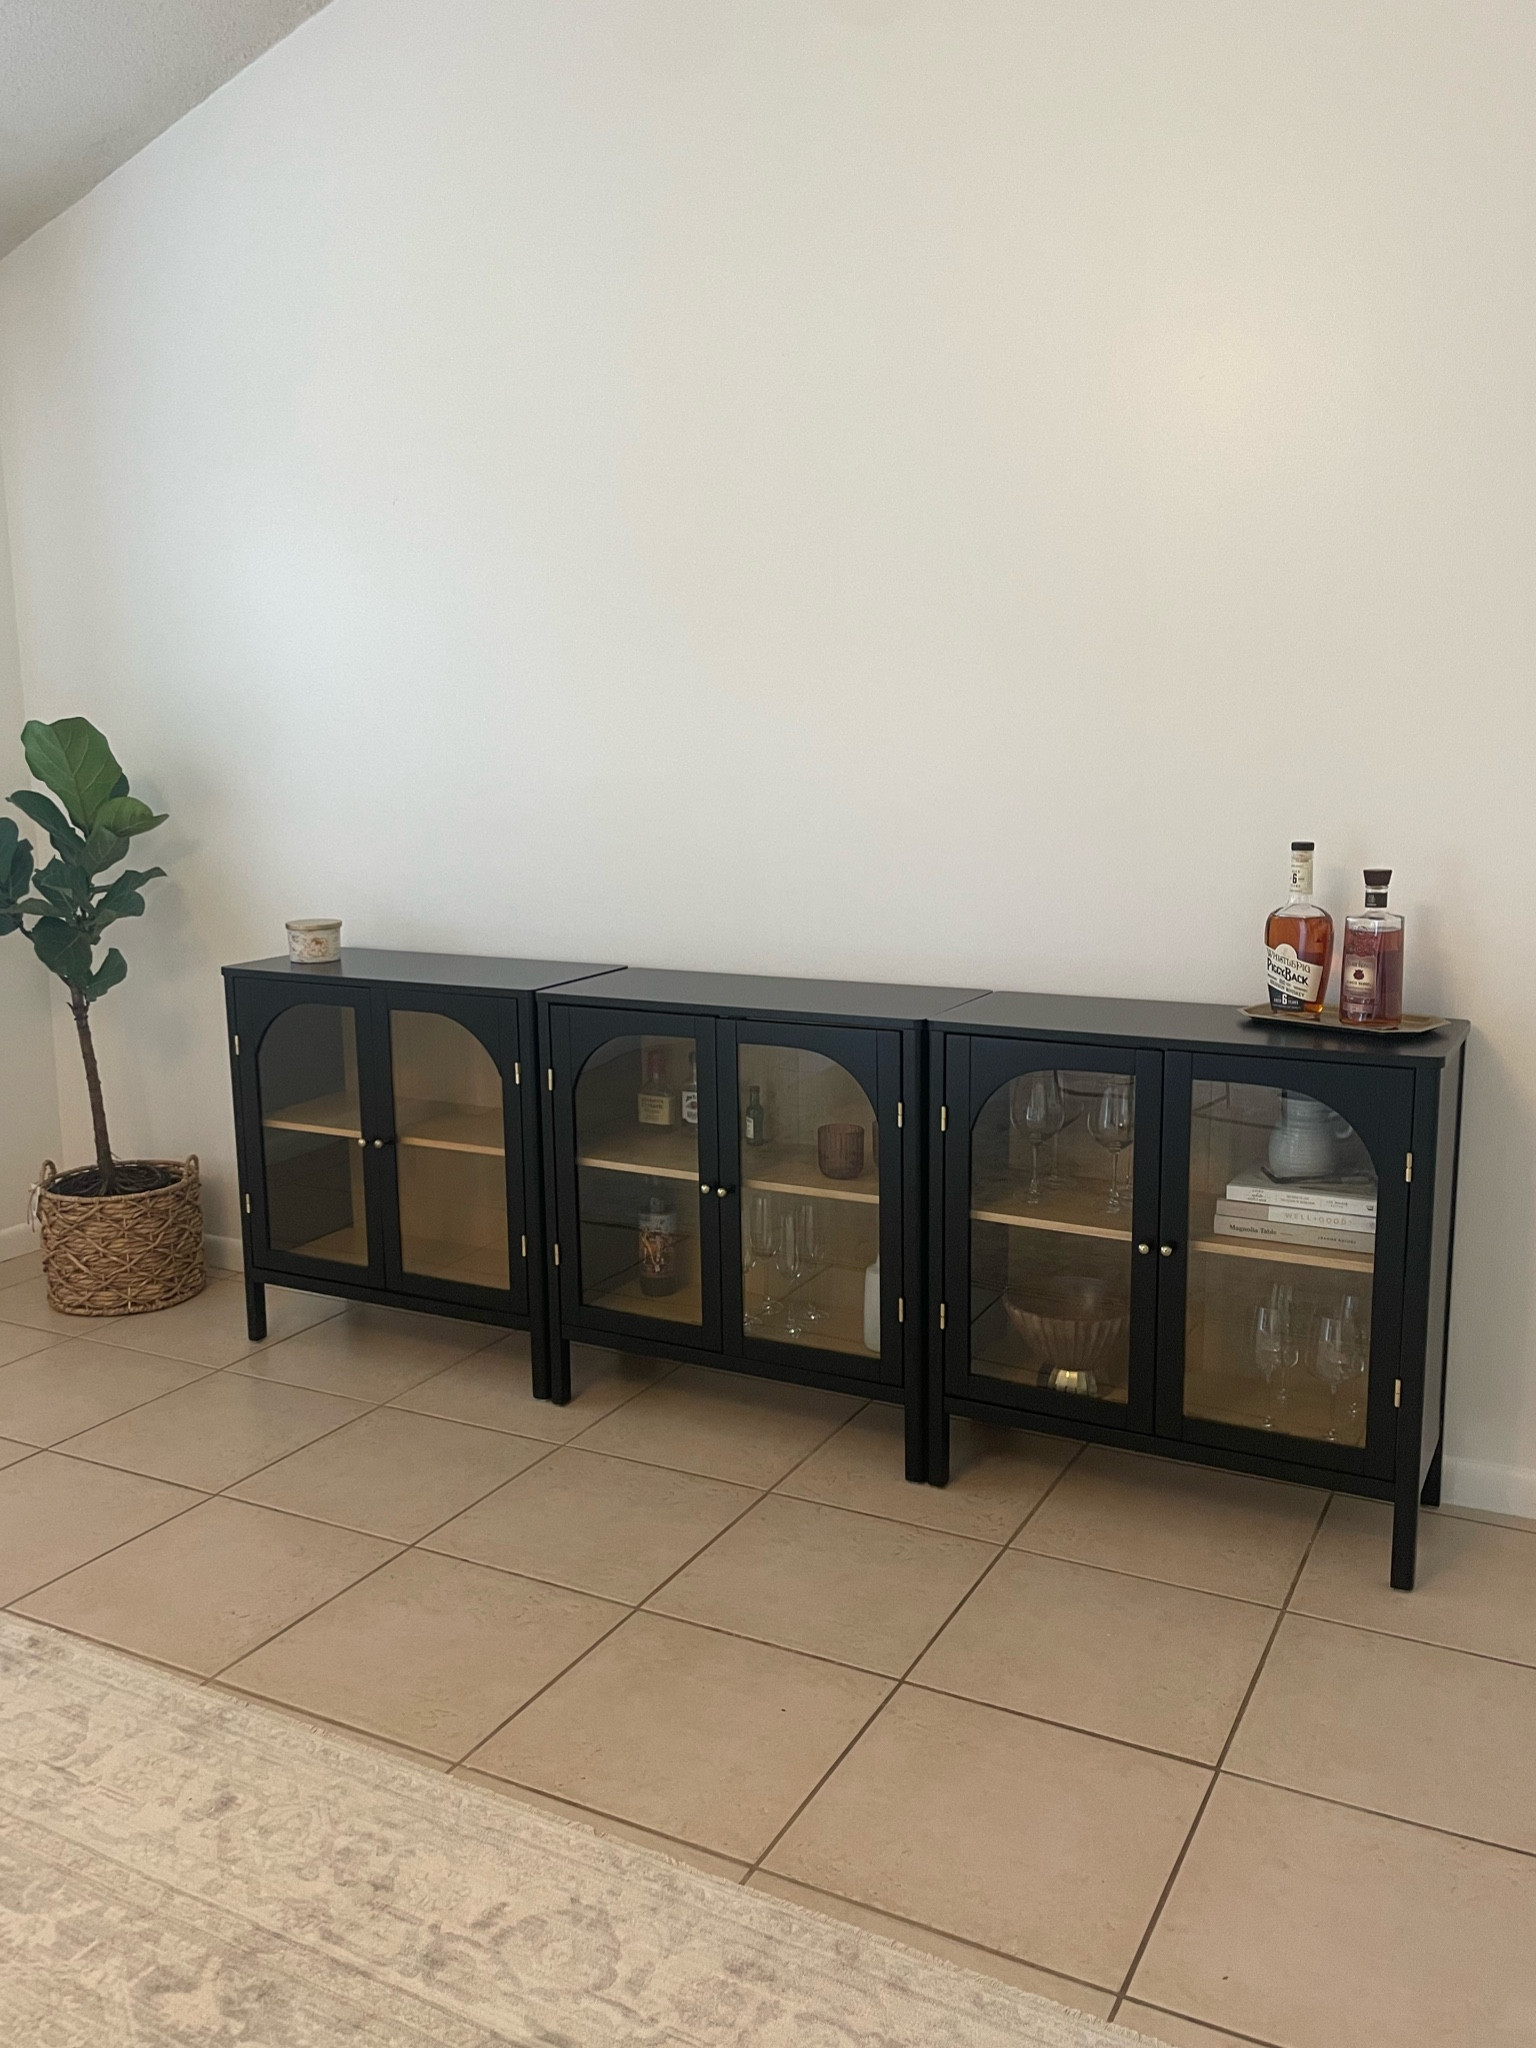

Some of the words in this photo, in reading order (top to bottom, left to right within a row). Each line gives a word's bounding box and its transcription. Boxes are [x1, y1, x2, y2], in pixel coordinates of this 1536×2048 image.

[1292, 873, 1298, 884] 6
[1282, 993, 1288, 1005] 6
[1229, 1224, 1259, 1234] Magnolia
[1260, 1227, 1277, 1235] Table
